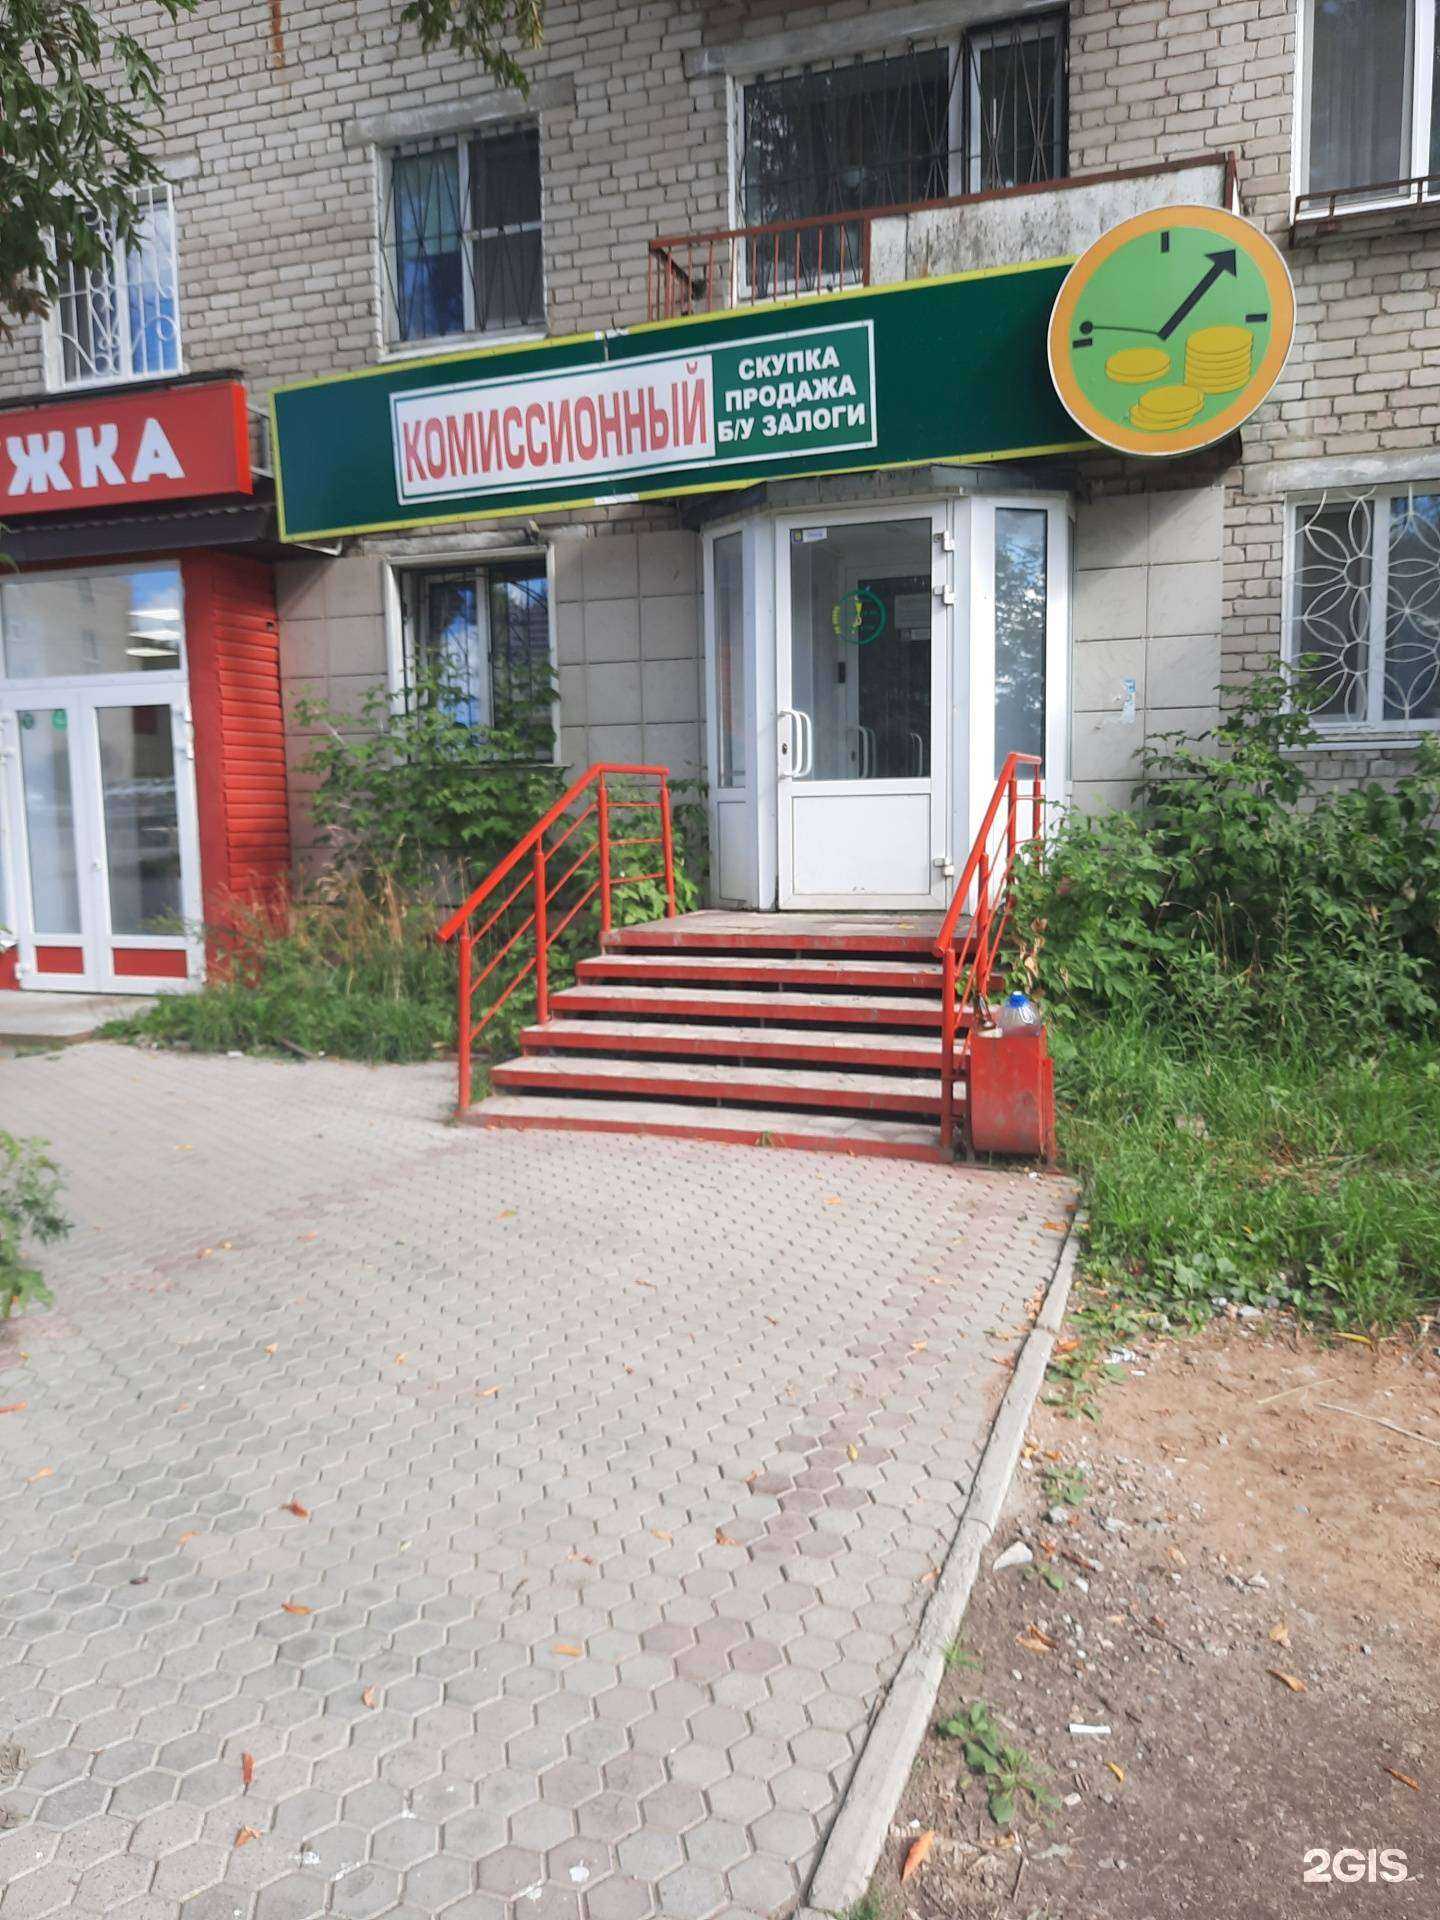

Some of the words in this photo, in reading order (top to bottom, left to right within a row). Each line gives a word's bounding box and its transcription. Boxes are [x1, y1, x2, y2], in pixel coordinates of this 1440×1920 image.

[738, 345, 840, 381] СКУПКА
[724, 374, 857, 412] ПРОДАЖА
[403, 361, 708, 482] КОМИССИОННЫЙ
[717, 417, 756, 443] Б/У
[762, 402, 866, 437] ЗАЛОГИ
